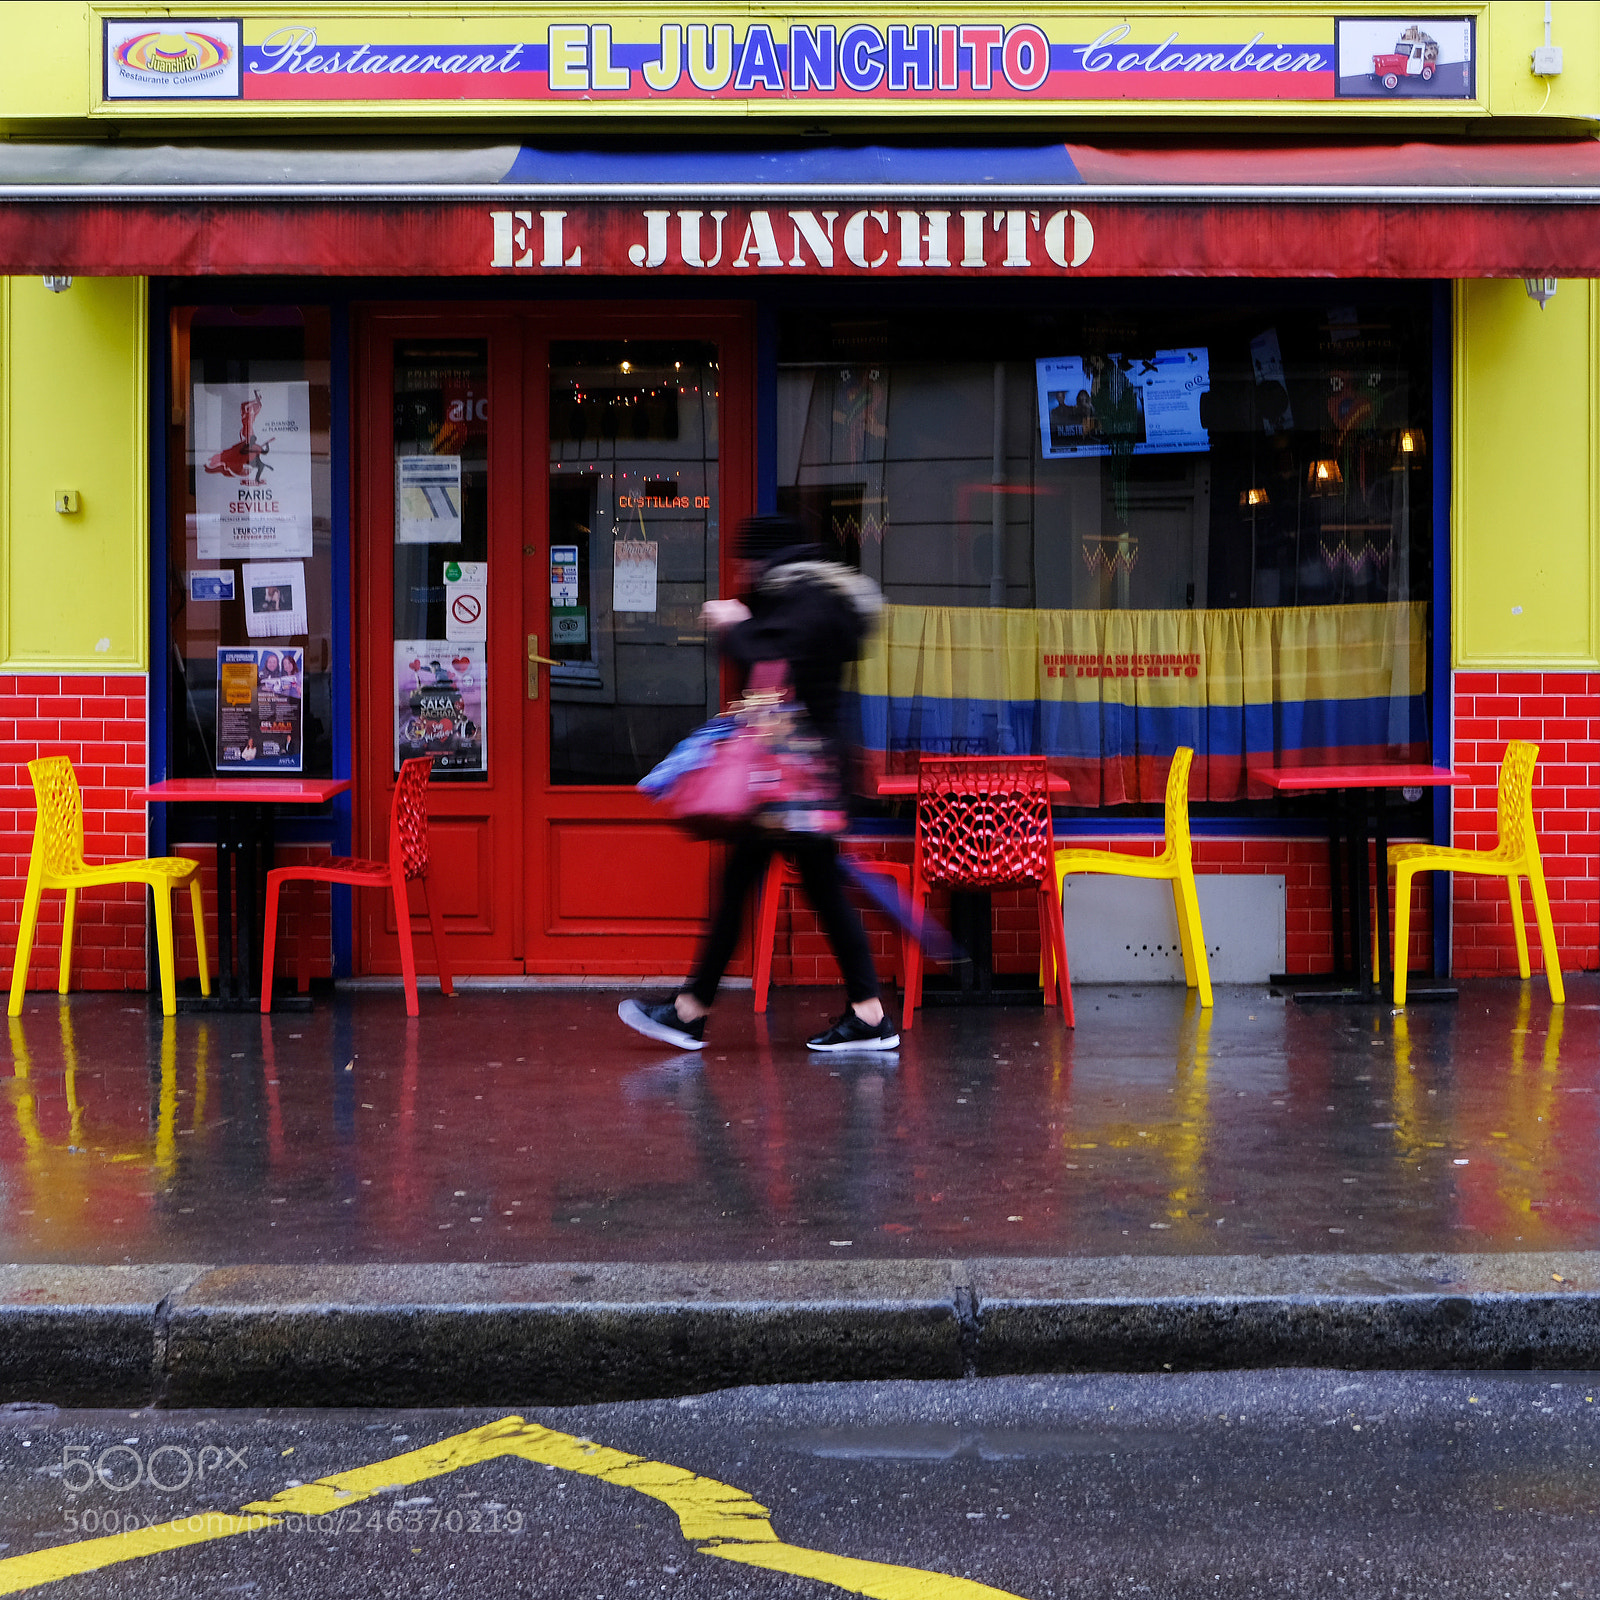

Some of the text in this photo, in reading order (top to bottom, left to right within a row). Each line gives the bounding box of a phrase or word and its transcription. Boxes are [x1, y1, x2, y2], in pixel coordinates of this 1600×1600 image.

[250, 25, 524, 75] Restaurant
[1073, 24, 1328, 75] Colombien
[147, 53, 198, 74] Juanchito
[547, 22, 1051, 92] EL JUANCHITO
[119, 68, 224, 85] Restaurante Colombiano
[489, 208, 1095, 269] EL JUANCHITO
[238, 489, 273, 501] PARIS
[694, 495, 711, 509] DE
[229, 501, 280, 514] SEVILLE
[1043, 654, 1201, 666] BIENVENIDO A SU RESTAURANTE
[1047, 667, 1199, 679] EL JUANCHITO
[420, 697, 454, 710] SALSA
[420, 708, 457, 719] BACHATA
